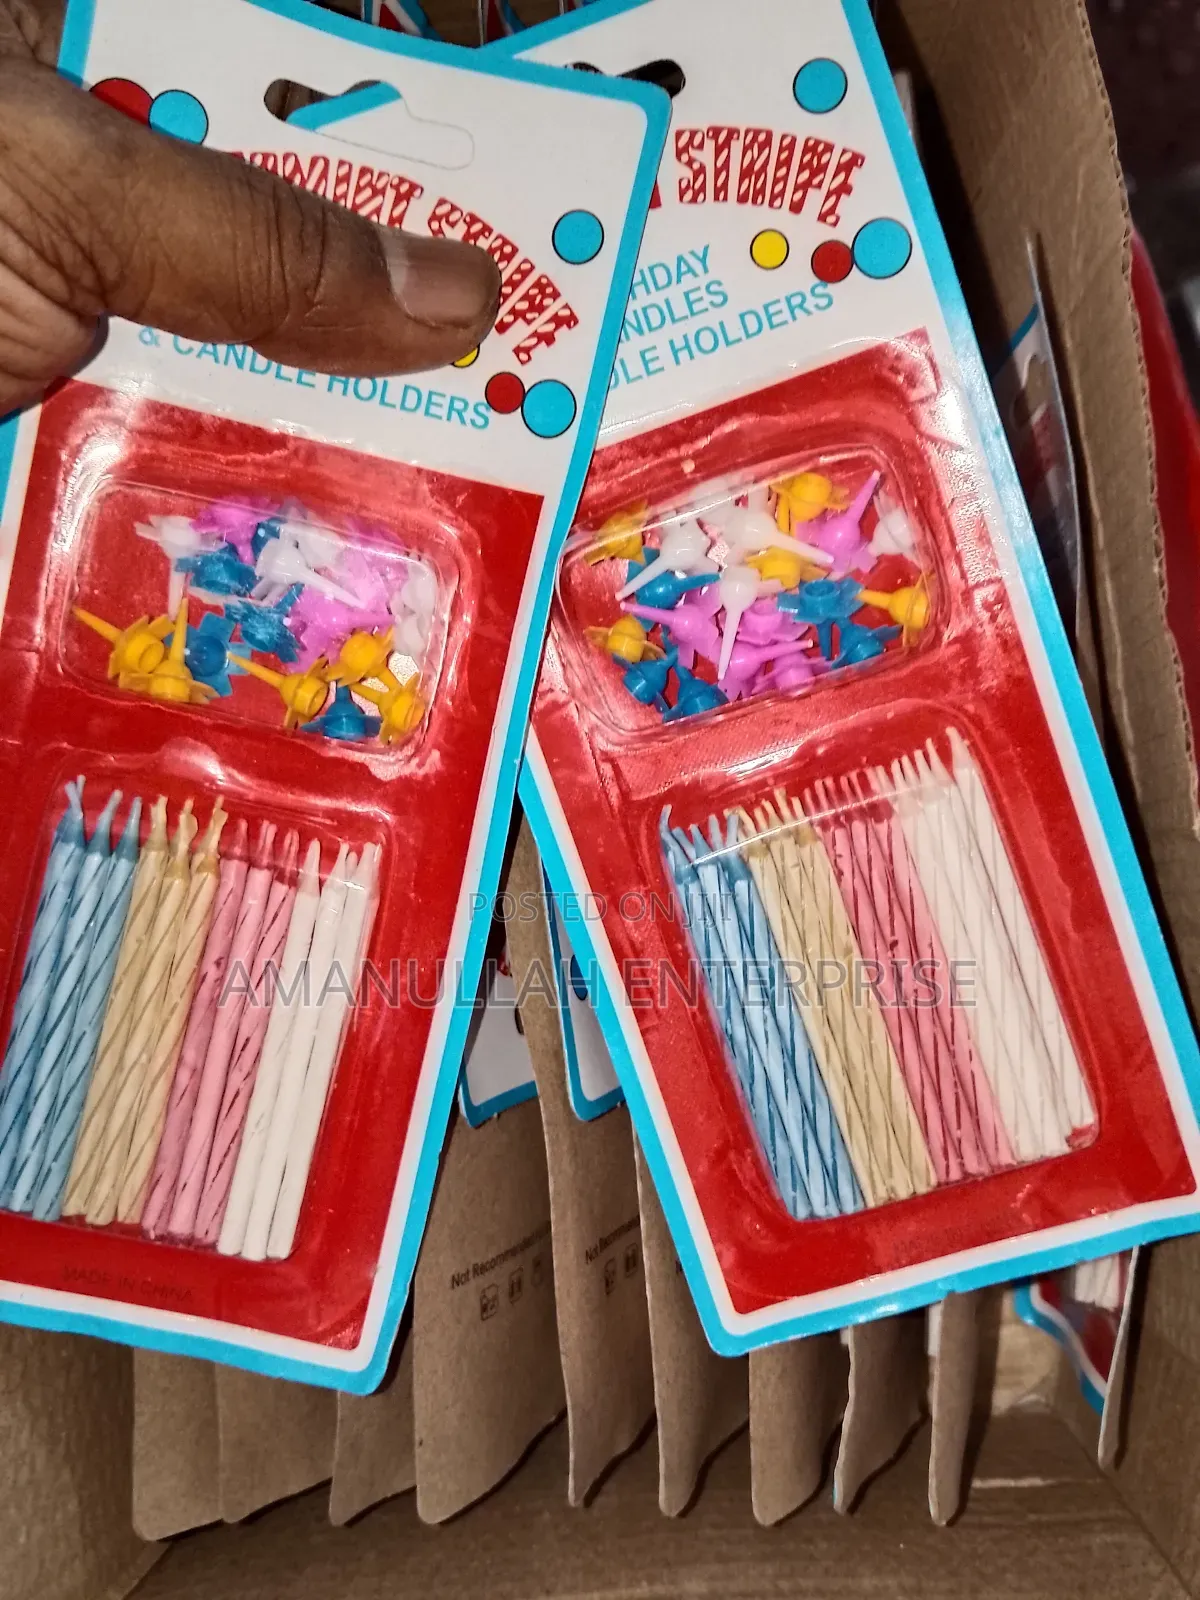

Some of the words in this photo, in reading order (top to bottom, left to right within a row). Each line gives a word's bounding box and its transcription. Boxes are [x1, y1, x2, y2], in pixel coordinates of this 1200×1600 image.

[675, 125, 865, 228] STRIPE
[619, 280, 729, 343] NDLES
[668, 281, 834, 366] HOLDERS
[138, 326, 160, 347] &
[173, 334, 316, 389] CANDLE
[327, 374, 492, 431] HOLDERS
[451, 1268, 470, 1290] Not
